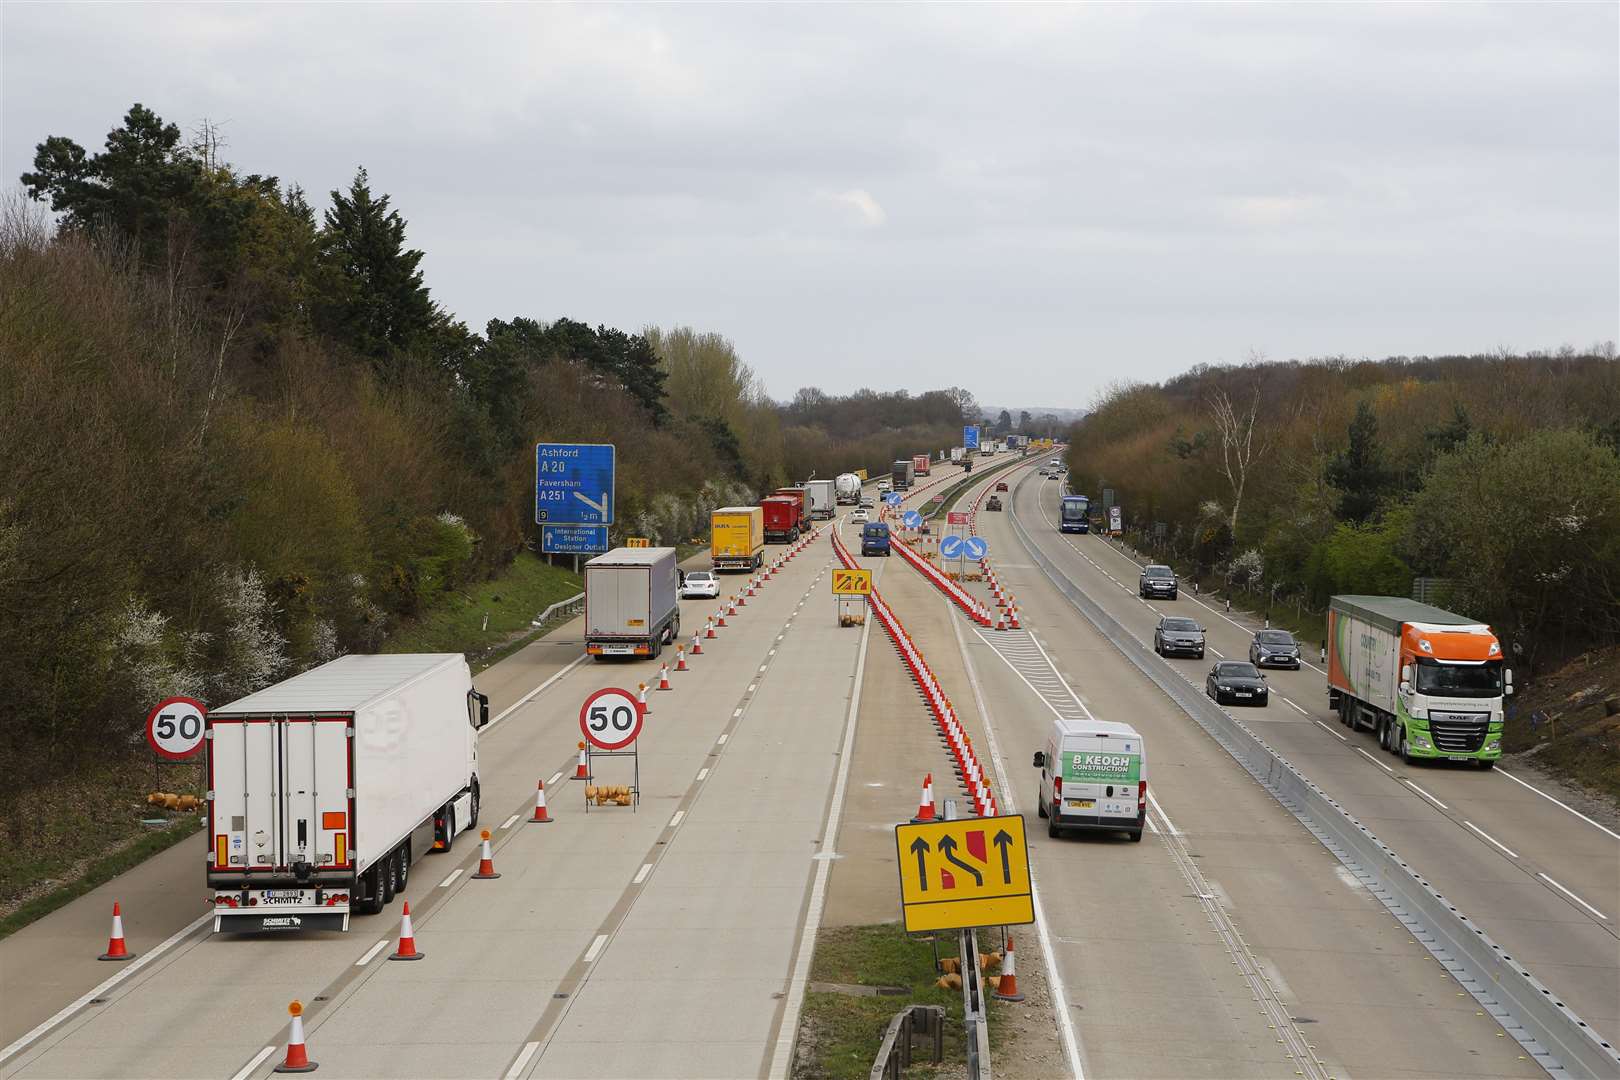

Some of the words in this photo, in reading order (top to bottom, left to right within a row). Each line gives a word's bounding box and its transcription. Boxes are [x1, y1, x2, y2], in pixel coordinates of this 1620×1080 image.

[541, 448, 579, 457] Ashford
[541, 461, 549, 473] A
[551, 461, 565, 473] 20
[539, 479, 581, 487] Faversham
[540, 511, 547, 519] 9
[555, 527, 596, 535] International
[554, 543, 582, 551] Designer
[590, 706, 633, 731] 50
[157, 714, 201, 740] 50
[1073, 755, 1081, 764] B
[1086, 755, 1130, 766] KEOGH
[1072, 764, 1129, 773] CONSTRUCTION
[263, 896, 303, 904] SCHMITZ
